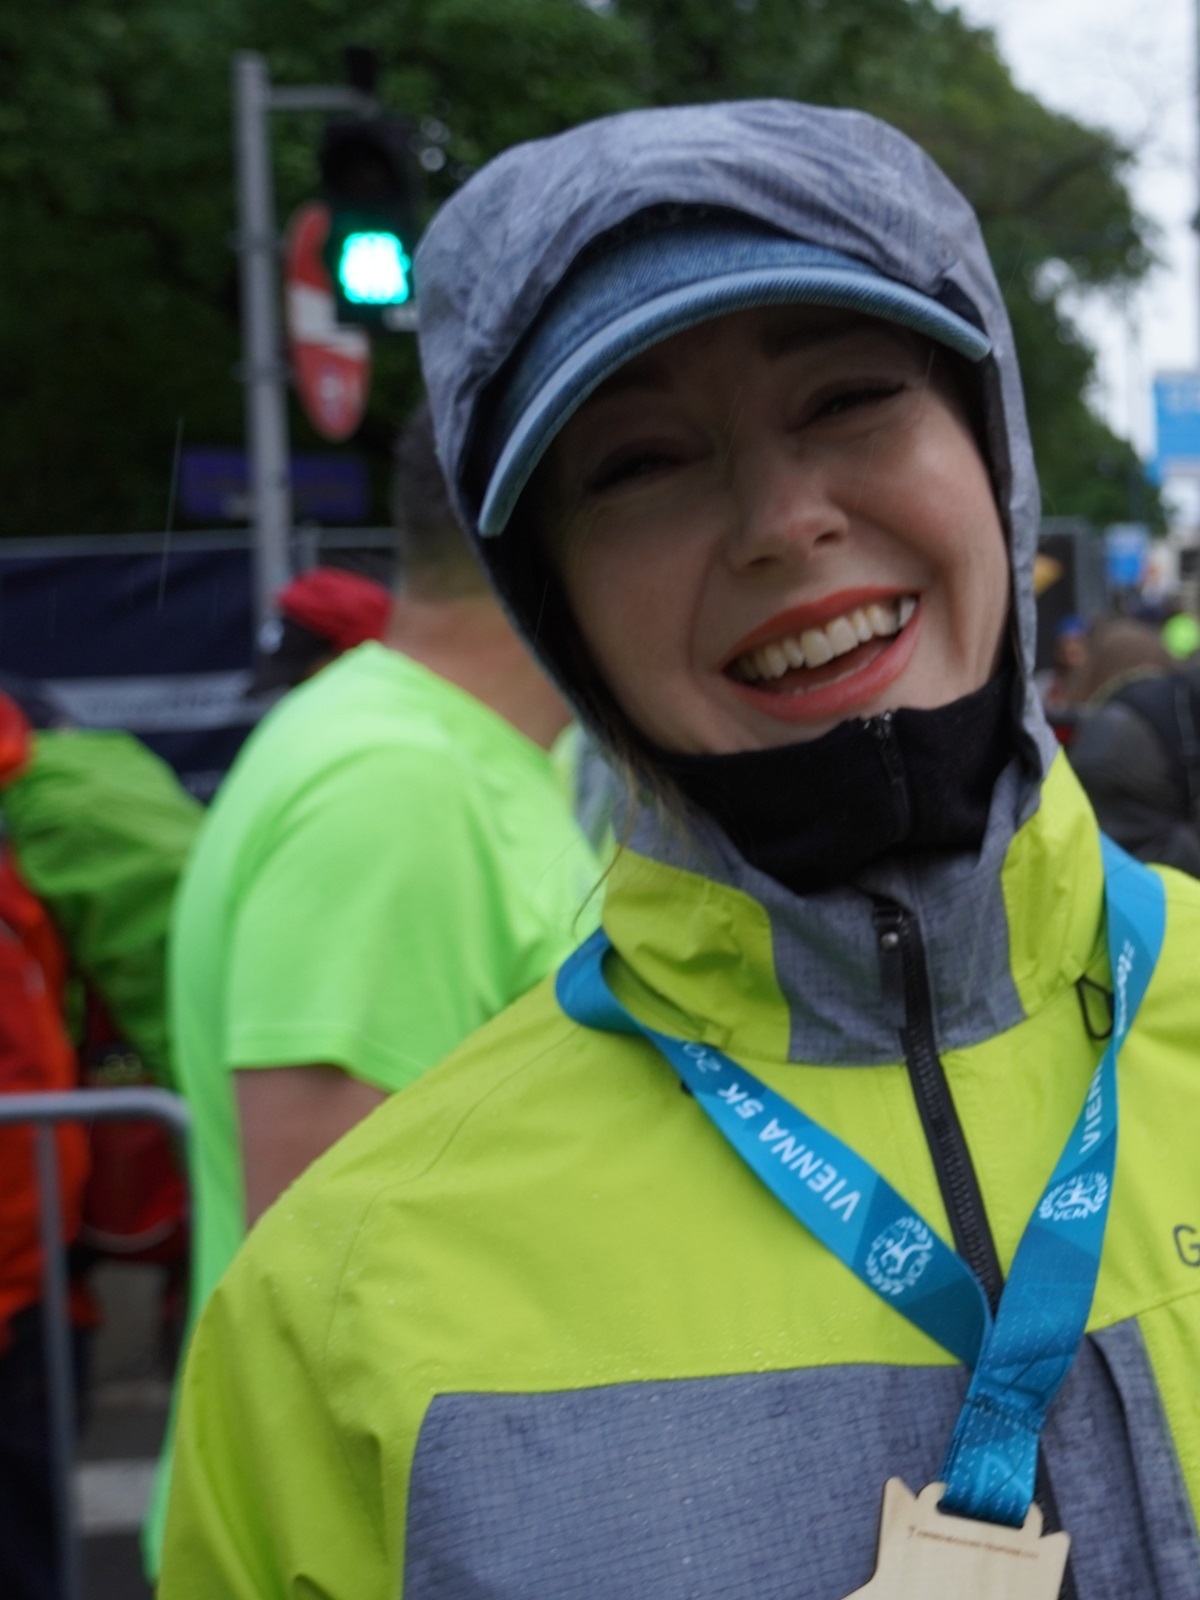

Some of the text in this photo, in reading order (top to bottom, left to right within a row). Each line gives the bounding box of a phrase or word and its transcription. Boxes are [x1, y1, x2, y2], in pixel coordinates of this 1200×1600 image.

[717, 1082, 764, 1119] 5K
[758, 1117, 861, 1223] VIENNA
[1053, 1205, 1089, 1222] VCM
